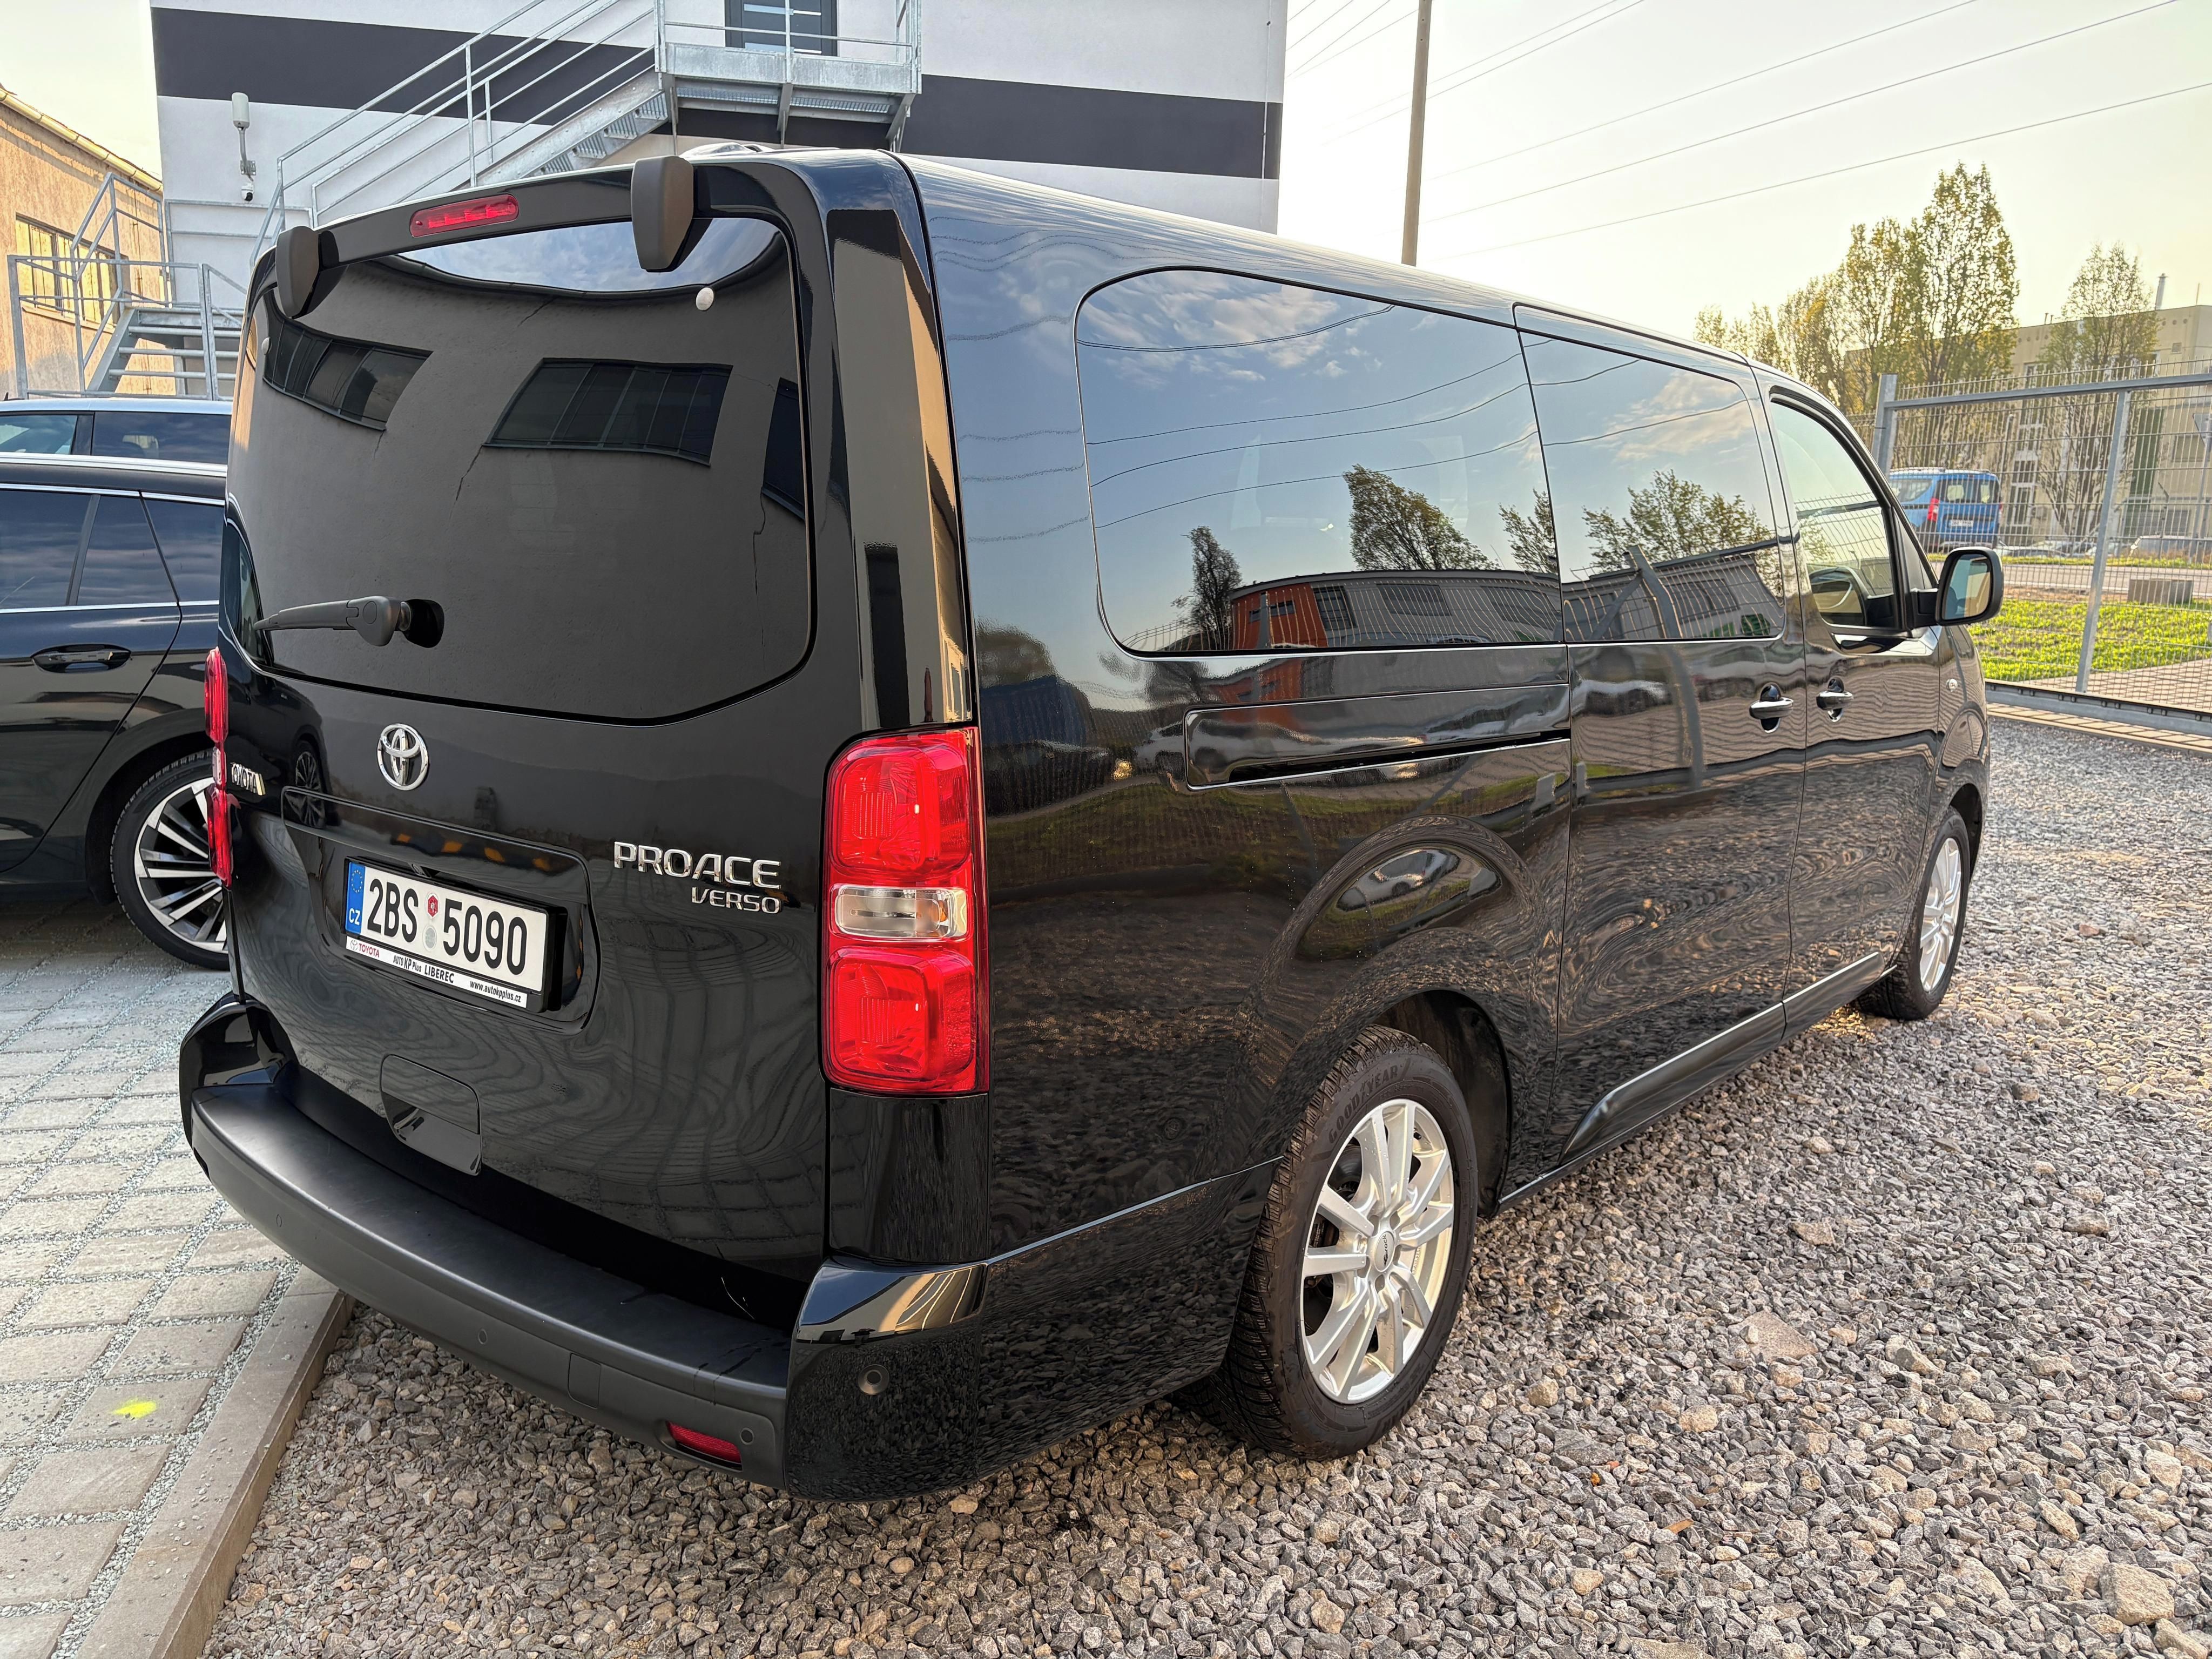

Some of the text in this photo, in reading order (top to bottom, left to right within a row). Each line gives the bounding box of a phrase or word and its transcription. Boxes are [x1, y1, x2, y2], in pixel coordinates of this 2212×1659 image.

[613, 841, 781, 889] PROACE
[692, 887, 782, 914] VERSO
[349, 908, 360, 926] CZ
[367, 879, 528, 975] 2BS 5090
[359, 943, 380, 958] TOYOTA
[393, 955, 454, 983] AUTO KP Plus LIBEREC
[470, 980, 521, 1003] www.autokpplus.cz
